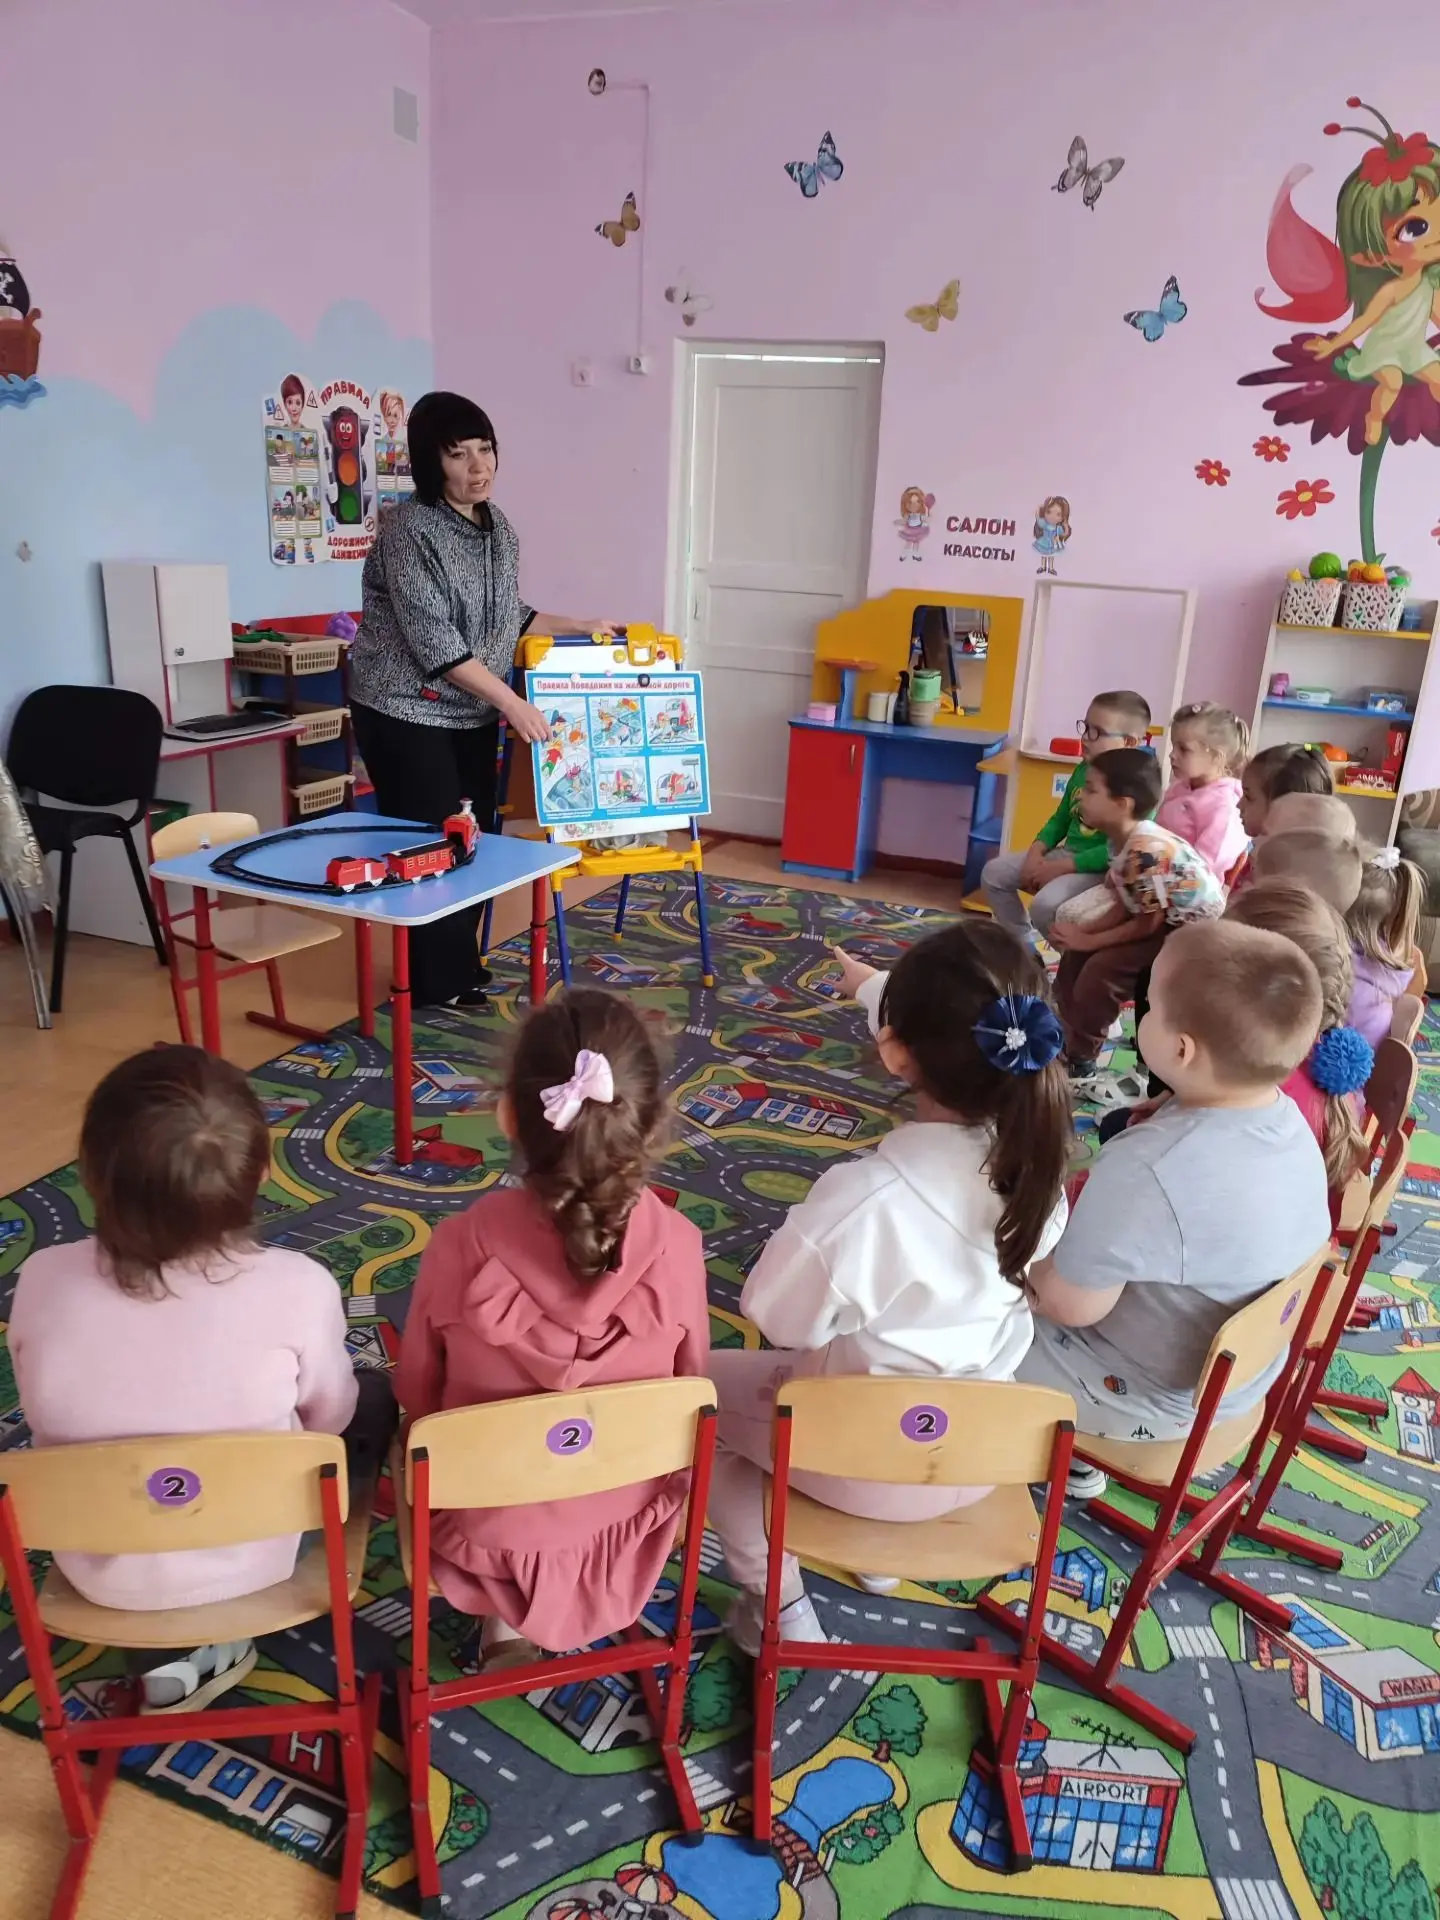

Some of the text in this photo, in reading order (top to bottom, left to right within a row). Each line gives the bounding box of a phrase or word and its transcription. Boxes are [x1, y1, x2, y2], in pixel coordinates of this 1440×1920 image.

[320, 381, 371, 409] ПРАВИЛА
[946, 516, 1016, 537] САЛОН
[328, 535, 376, 547] ДОРОЖНОГО
[331, 548, 368, 560] ДВИЖЕНИ
[943, 543, 1016, 562] КРАСОТЫ
[915, 1412, 936, 1434] 2
[560, 1425, 582, 1448] 2
[161, 1475, 188, 1498] 2
[289, 1731, 323, 1772] H
[1062, 1779, 1147, 1801] AIRPORT
